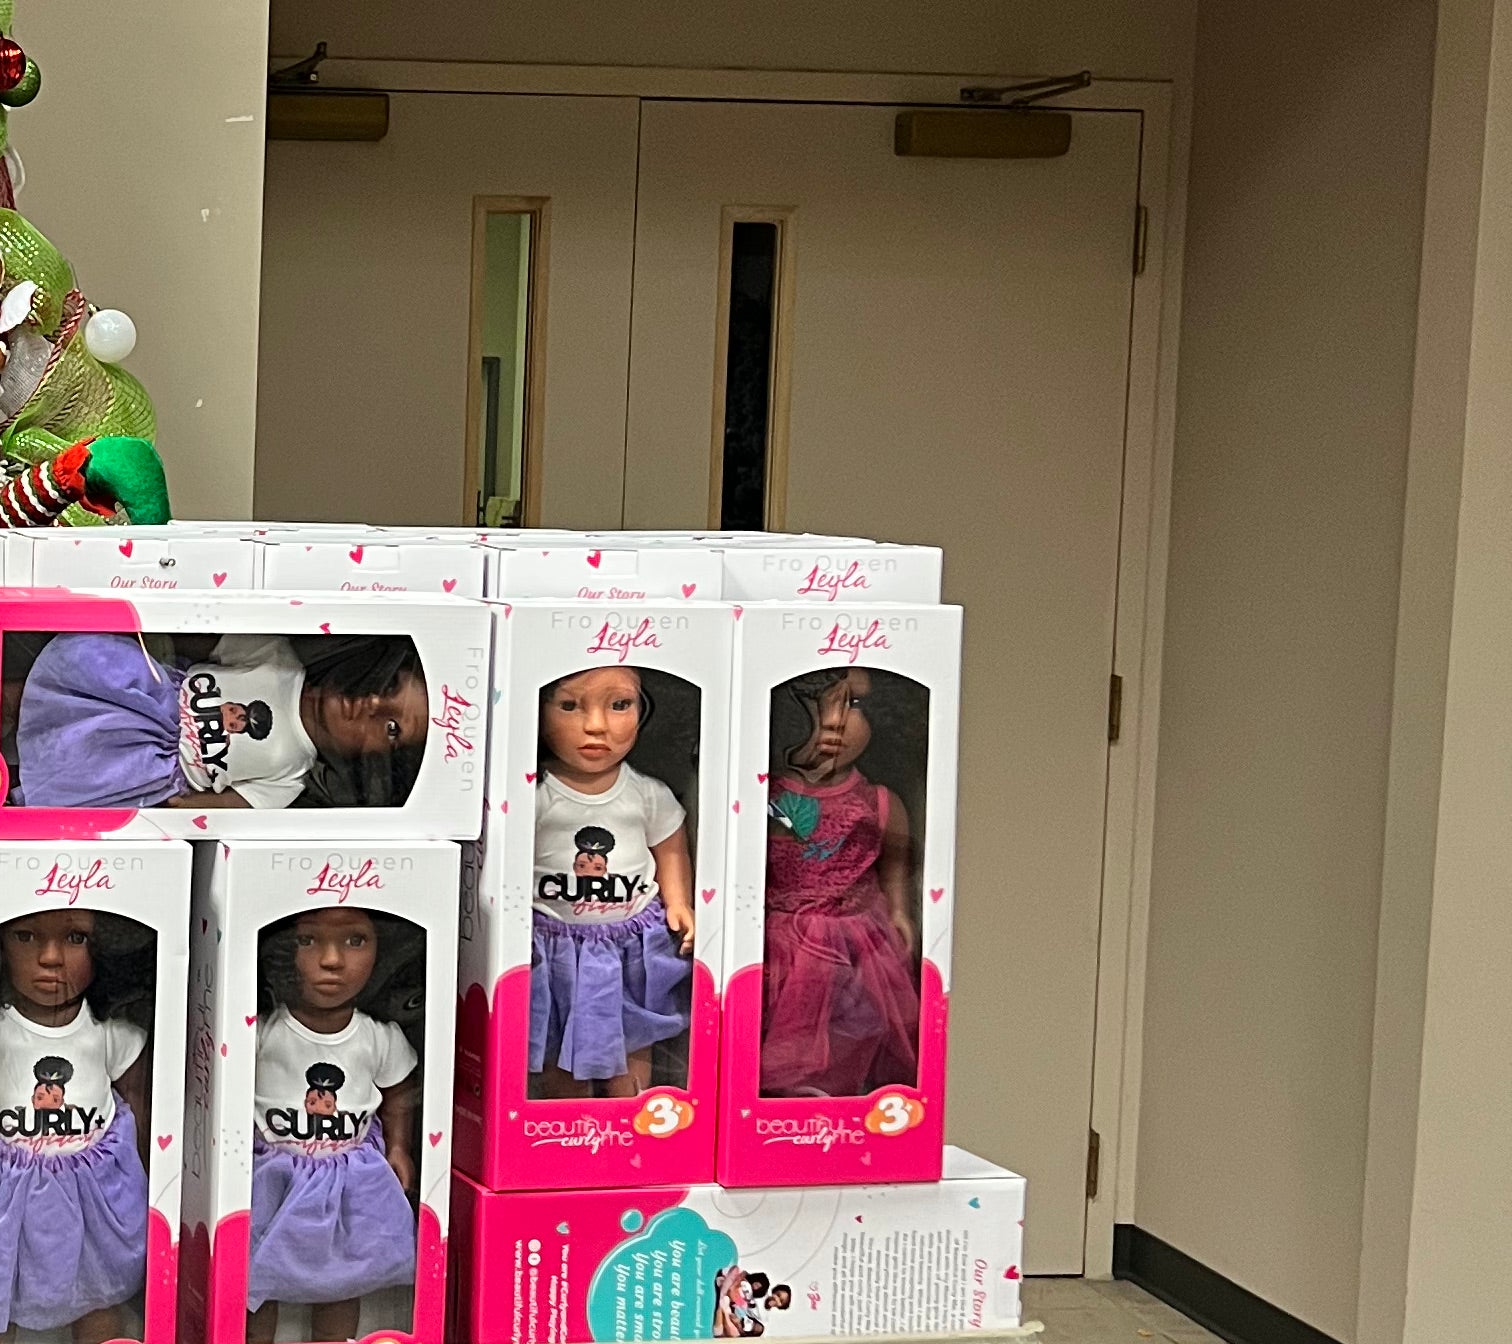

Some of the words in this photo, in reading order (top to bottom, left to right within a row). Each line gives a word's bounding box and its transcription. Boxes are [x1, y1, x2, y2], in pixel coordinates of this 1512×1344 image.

[551, 612, 592, 630] Fro
[782, 613, 822, 631] Fro
[272, 853, 313, 871] Fro
[631, 1252, 649, 1281] You
[650, 1249, 668, 1278] You
[668, 1240, 686, 1268] You
[613, 1263, 631, 1292] You
